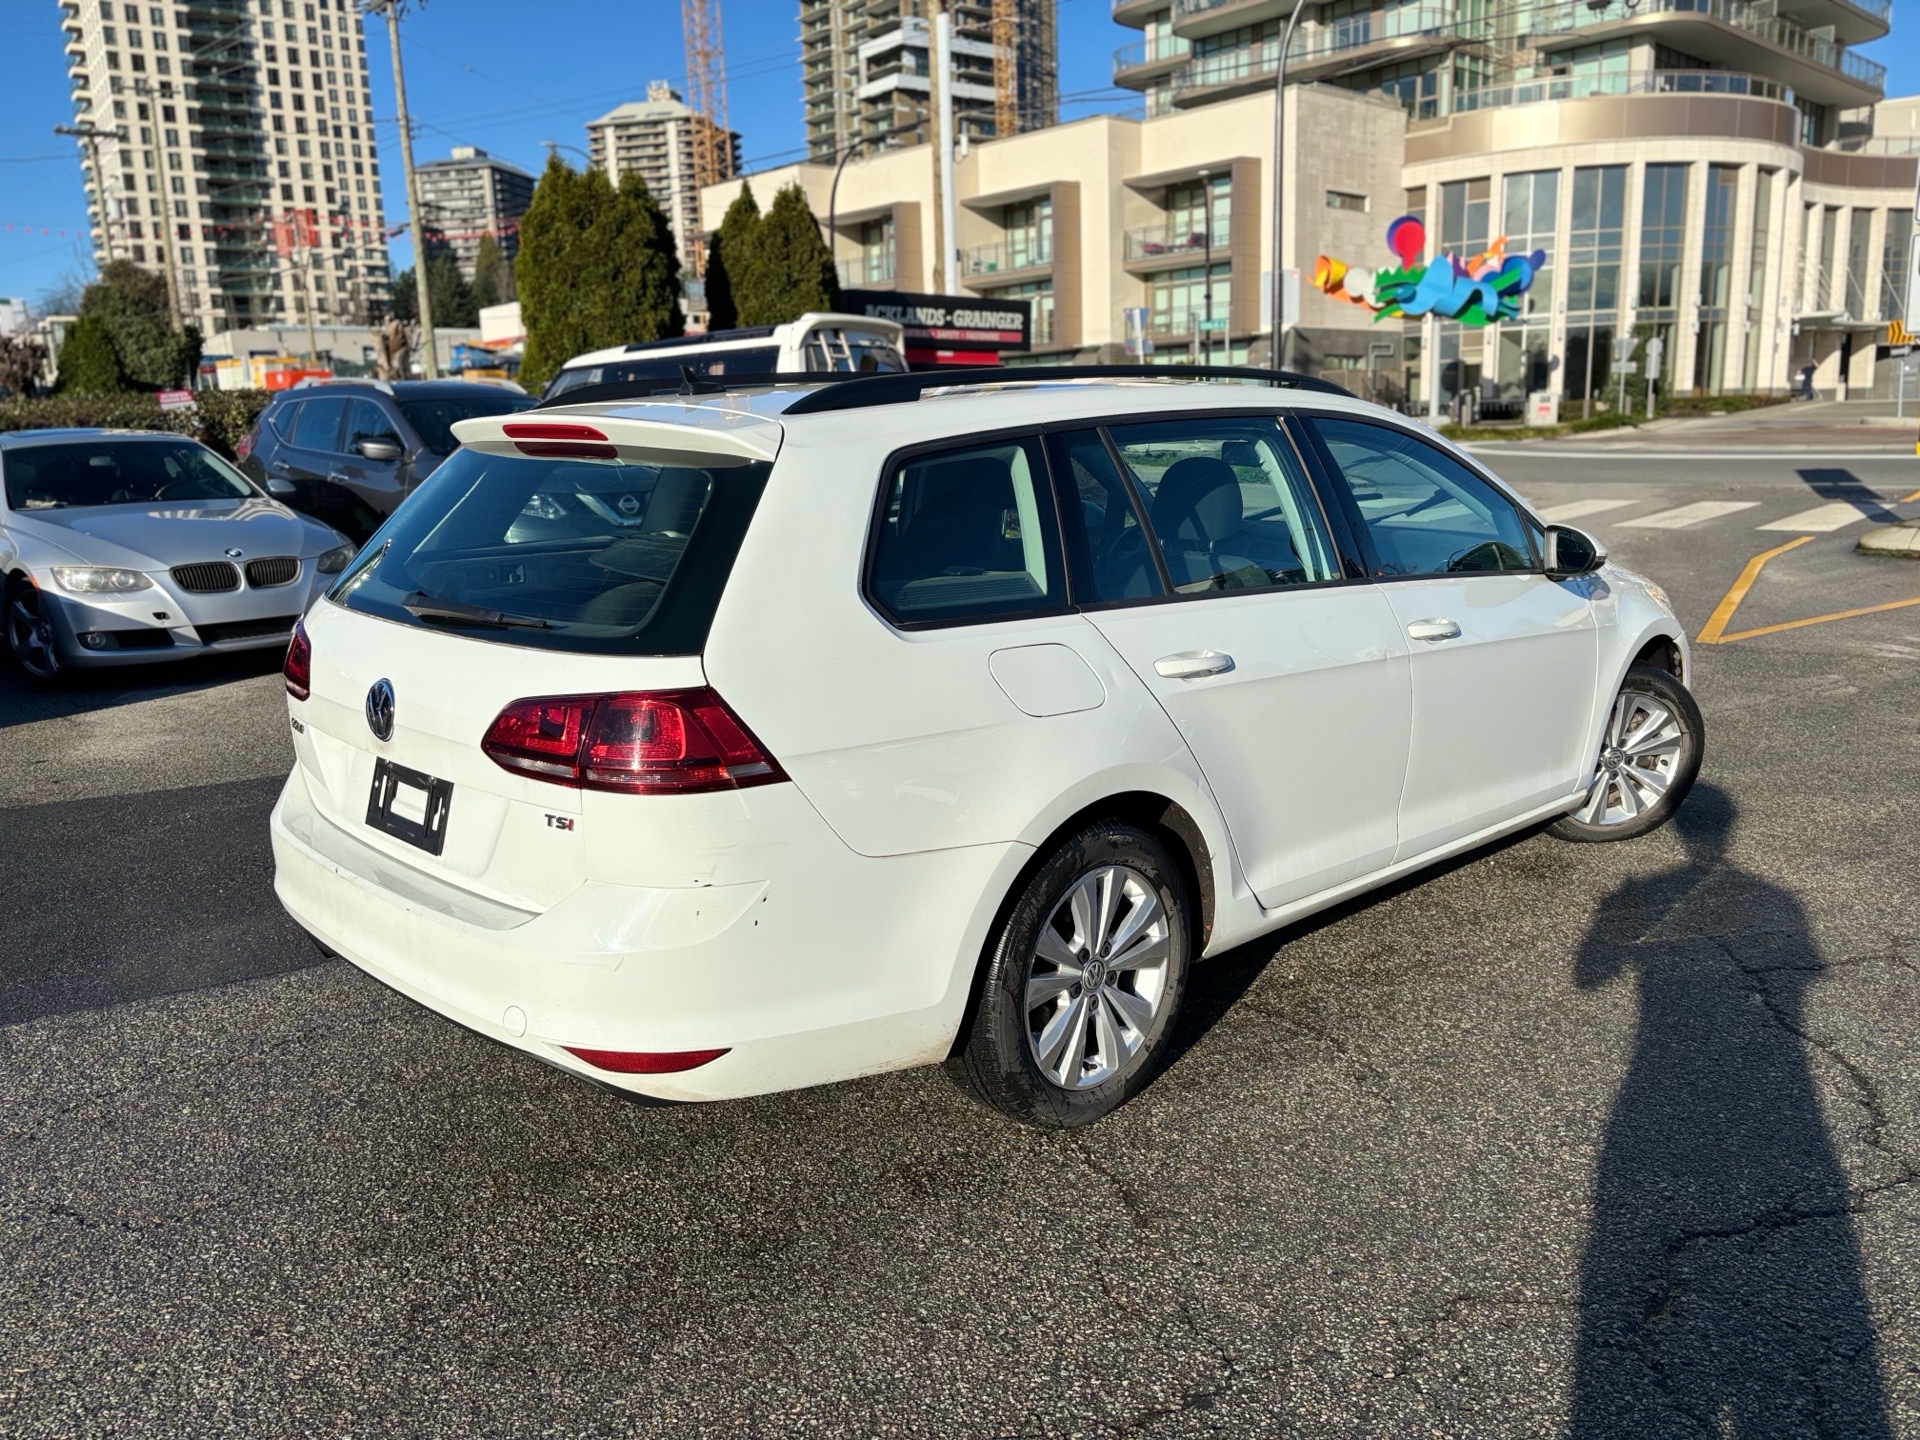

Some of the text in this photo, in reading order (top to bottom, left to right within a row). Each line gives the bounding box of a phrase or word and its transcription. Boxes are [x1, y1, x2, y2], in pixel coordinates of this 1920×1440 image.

[865, 304, 1024, 330] ACKLANDS GRAINGER
[544, 813, 574, 832] TSI
